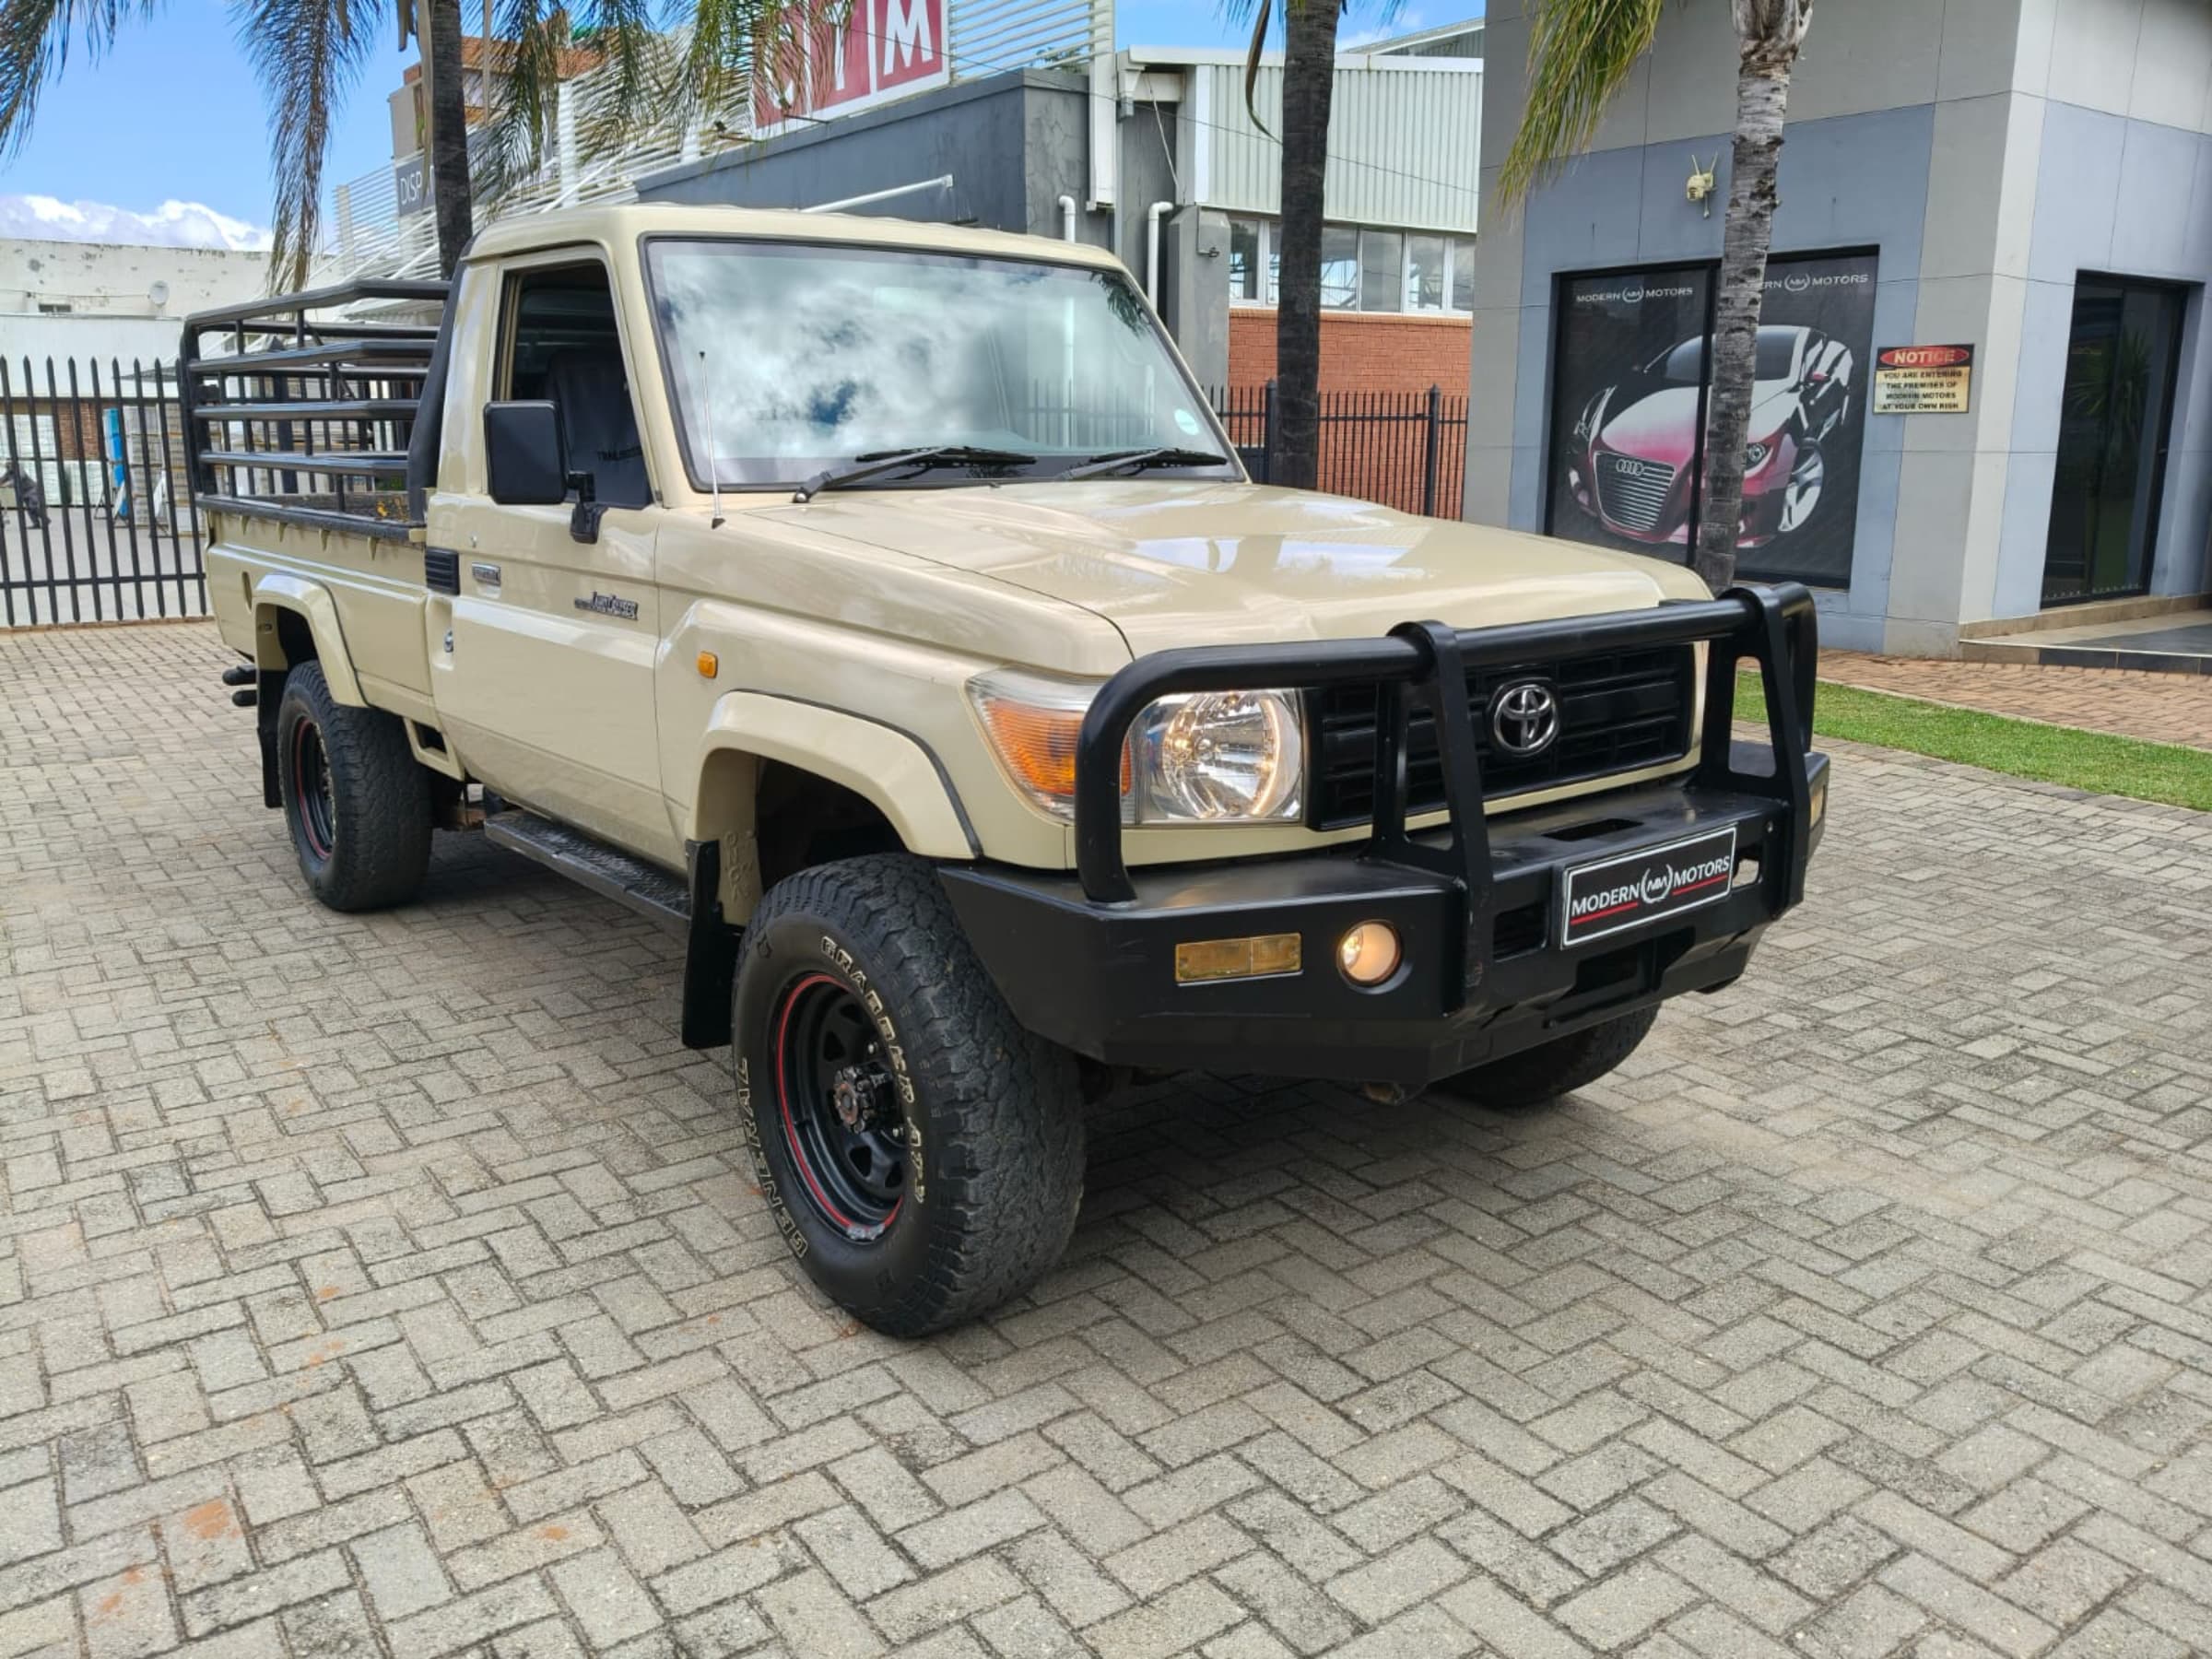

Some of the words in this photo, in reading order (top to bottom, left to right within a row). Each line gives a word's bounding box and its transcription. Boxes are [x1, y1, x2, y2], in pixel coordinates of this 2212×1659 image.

[1812, 274, 1868, 286] MOTORS
[1576, 292, 1621, 302] MODERN
[1645, 287, 1694, 298] MOTORS
[1894, 350, 1955, 364] NOTICE
[1920, 370, 1962, 378] ENTERING
[1571, 882, 1641, 917] MODERN
[1673, 855, 1731, 887] MOTORS
[821, 935, 914, 1103] GRABBER
[737, 1057, 808, 1258] GENERAL
